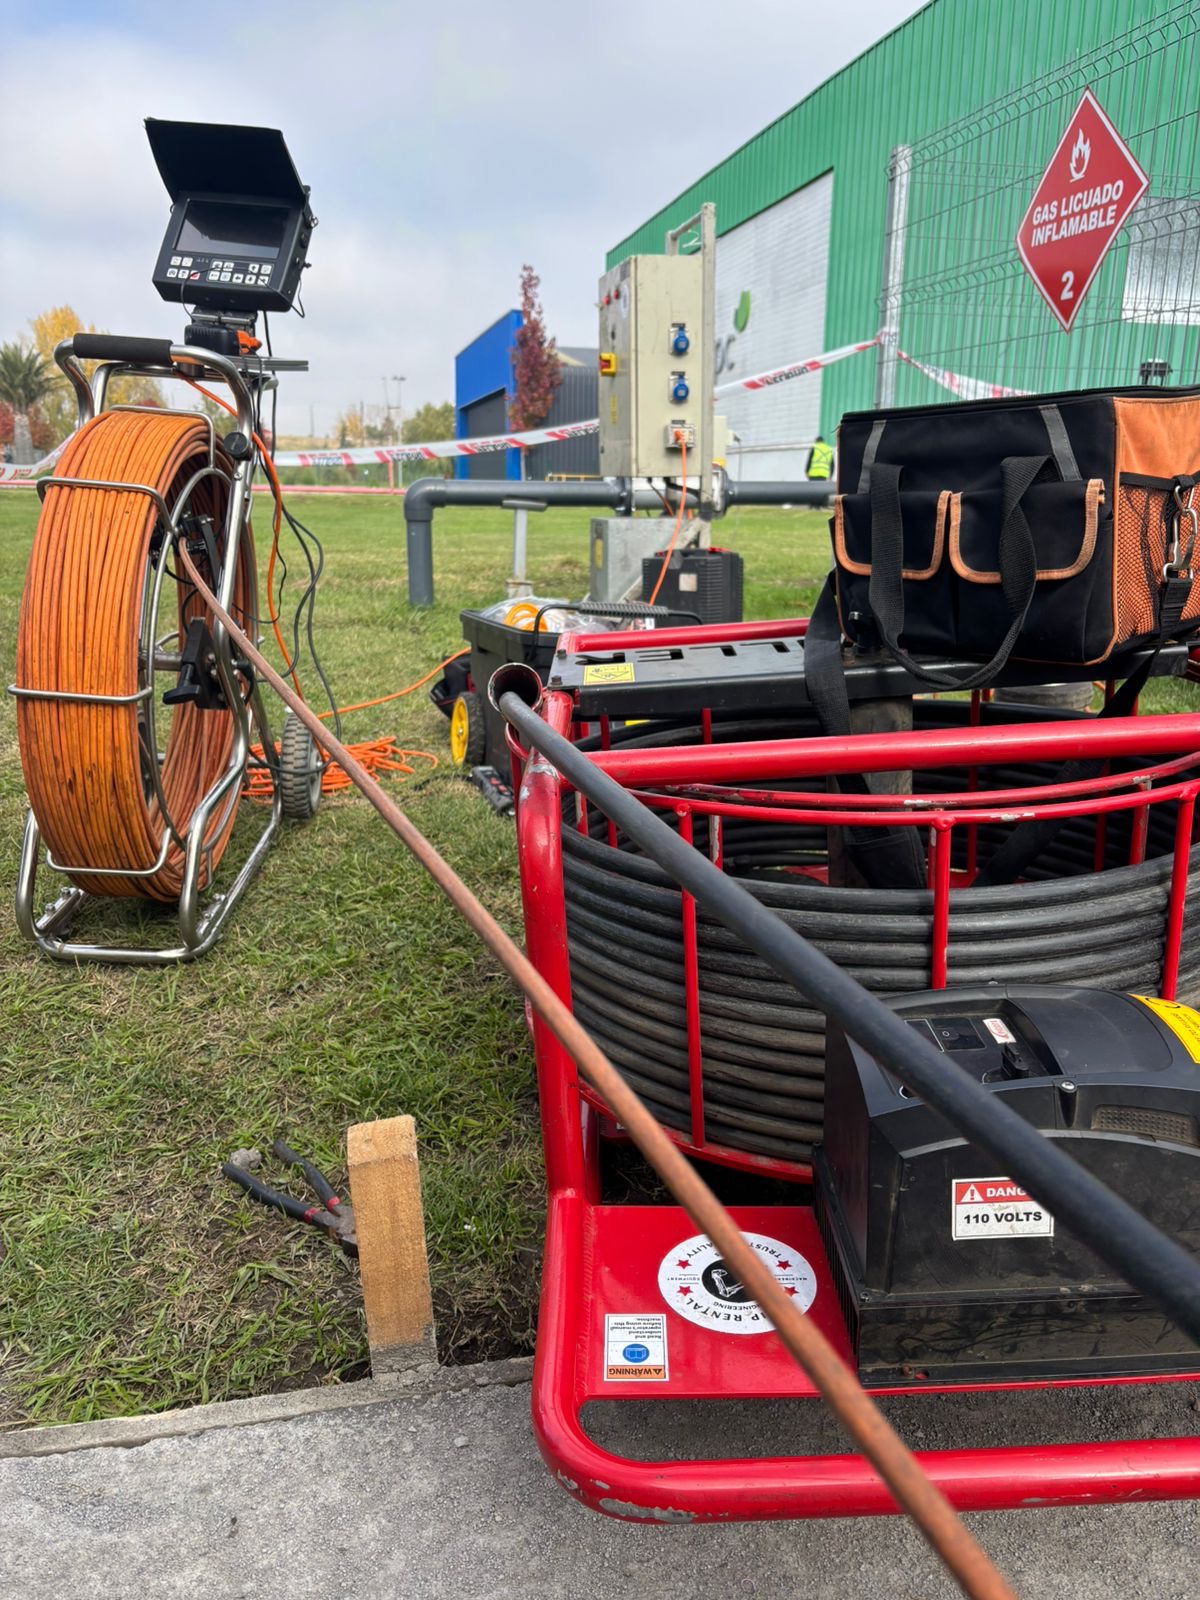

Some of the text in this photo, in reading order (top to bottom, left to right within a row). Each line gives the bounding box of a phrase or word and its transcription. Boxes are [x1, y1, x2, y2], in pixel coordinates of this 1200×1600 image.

[1032, 179, 1124, 226] GAS LICUADO
[1031, 204, 1118, 248] INFLAMABLE
[1060, 270, 1075, 301] 2
[964, 1211, 1042, 1224] 110 VOLTS
[686, 1241, 713, 1259] ALITY
[686, 1297, 743, 1322] RENTAL
[713, 1302, 759, 1311] GINEERING
